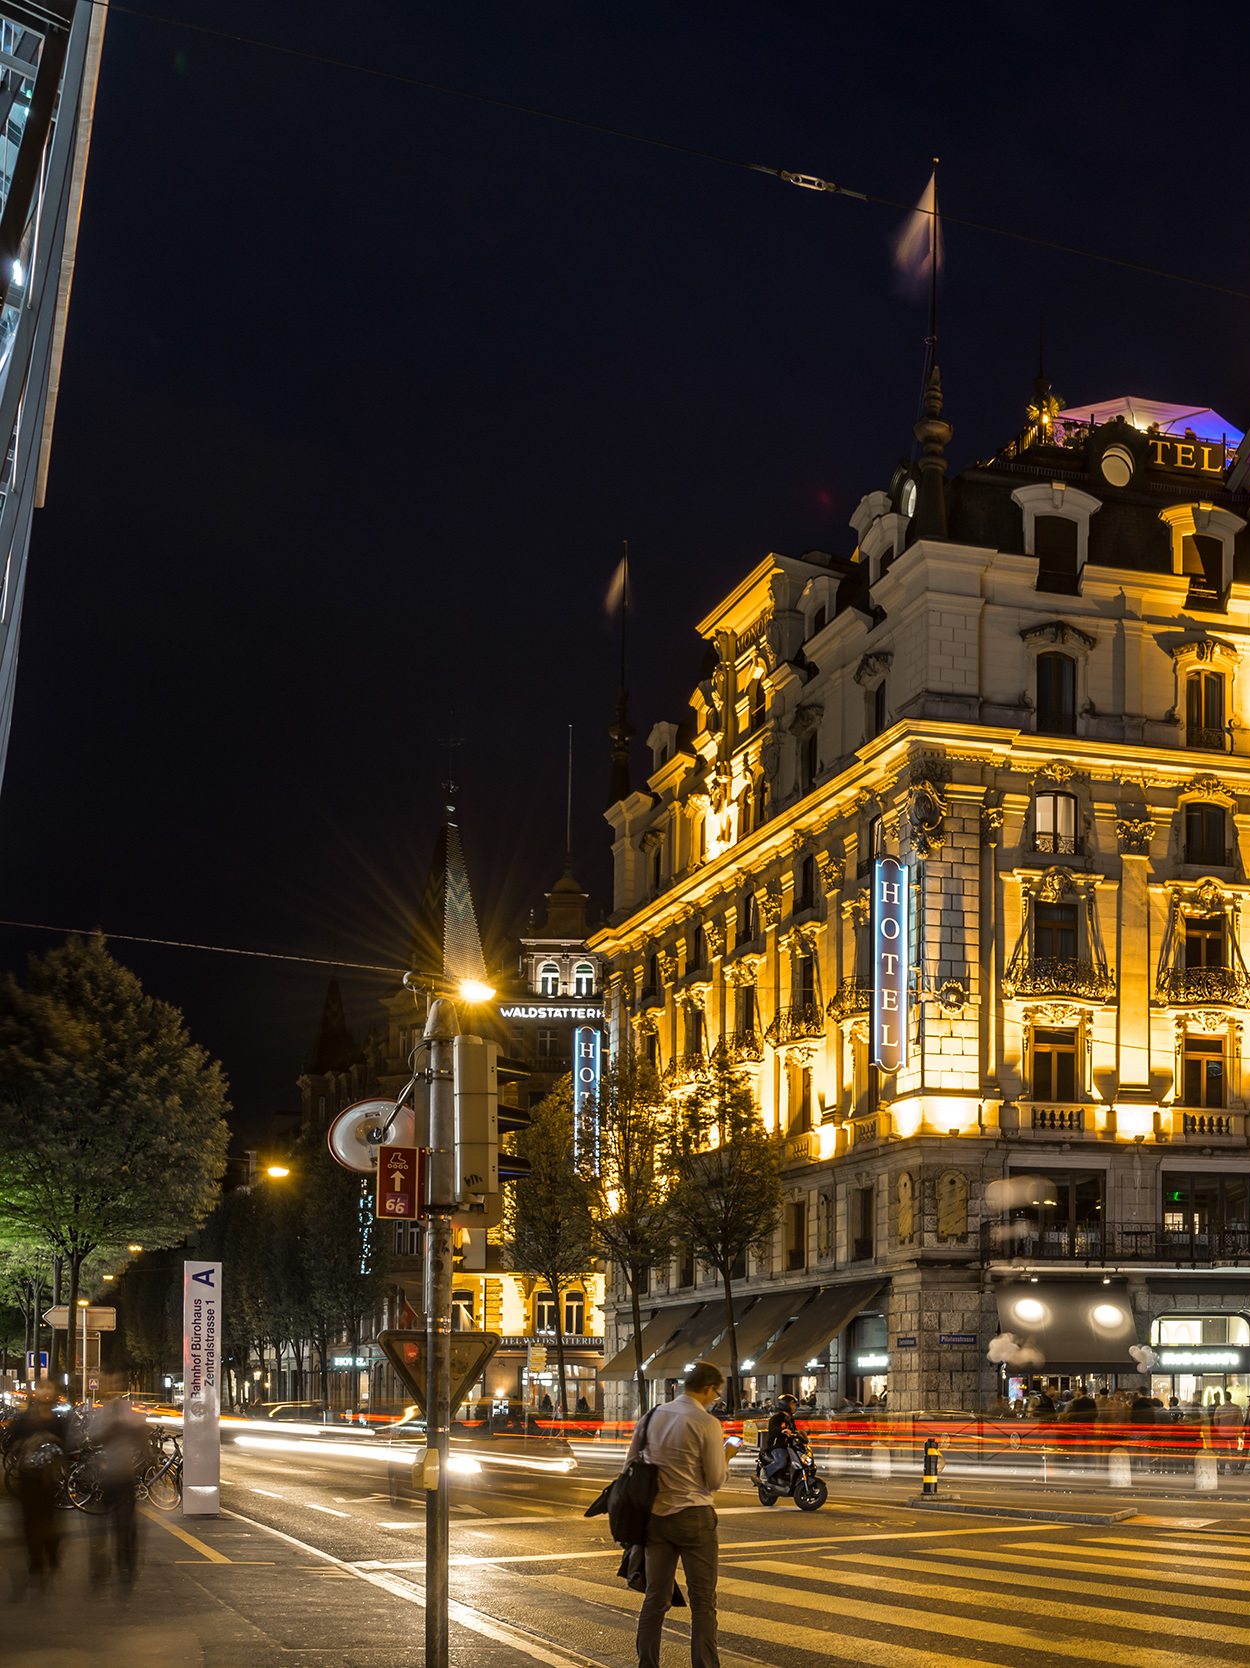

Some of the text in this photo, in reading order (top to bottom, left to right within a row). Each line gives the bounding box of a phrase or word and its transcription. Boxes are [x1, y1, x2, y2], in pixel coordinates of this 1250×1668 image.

[1148, 439, 1222, 472] TEL
[880, 880, 900, 1047] HOTEL
[579, 1042, 595, 1145] HOTE
[191, 1268, 215, 1288] A
[191, 1298, 202, 1400] Bahnhof Bürohaus
[204, 1308, 215, 1387] Zentralstrasse
